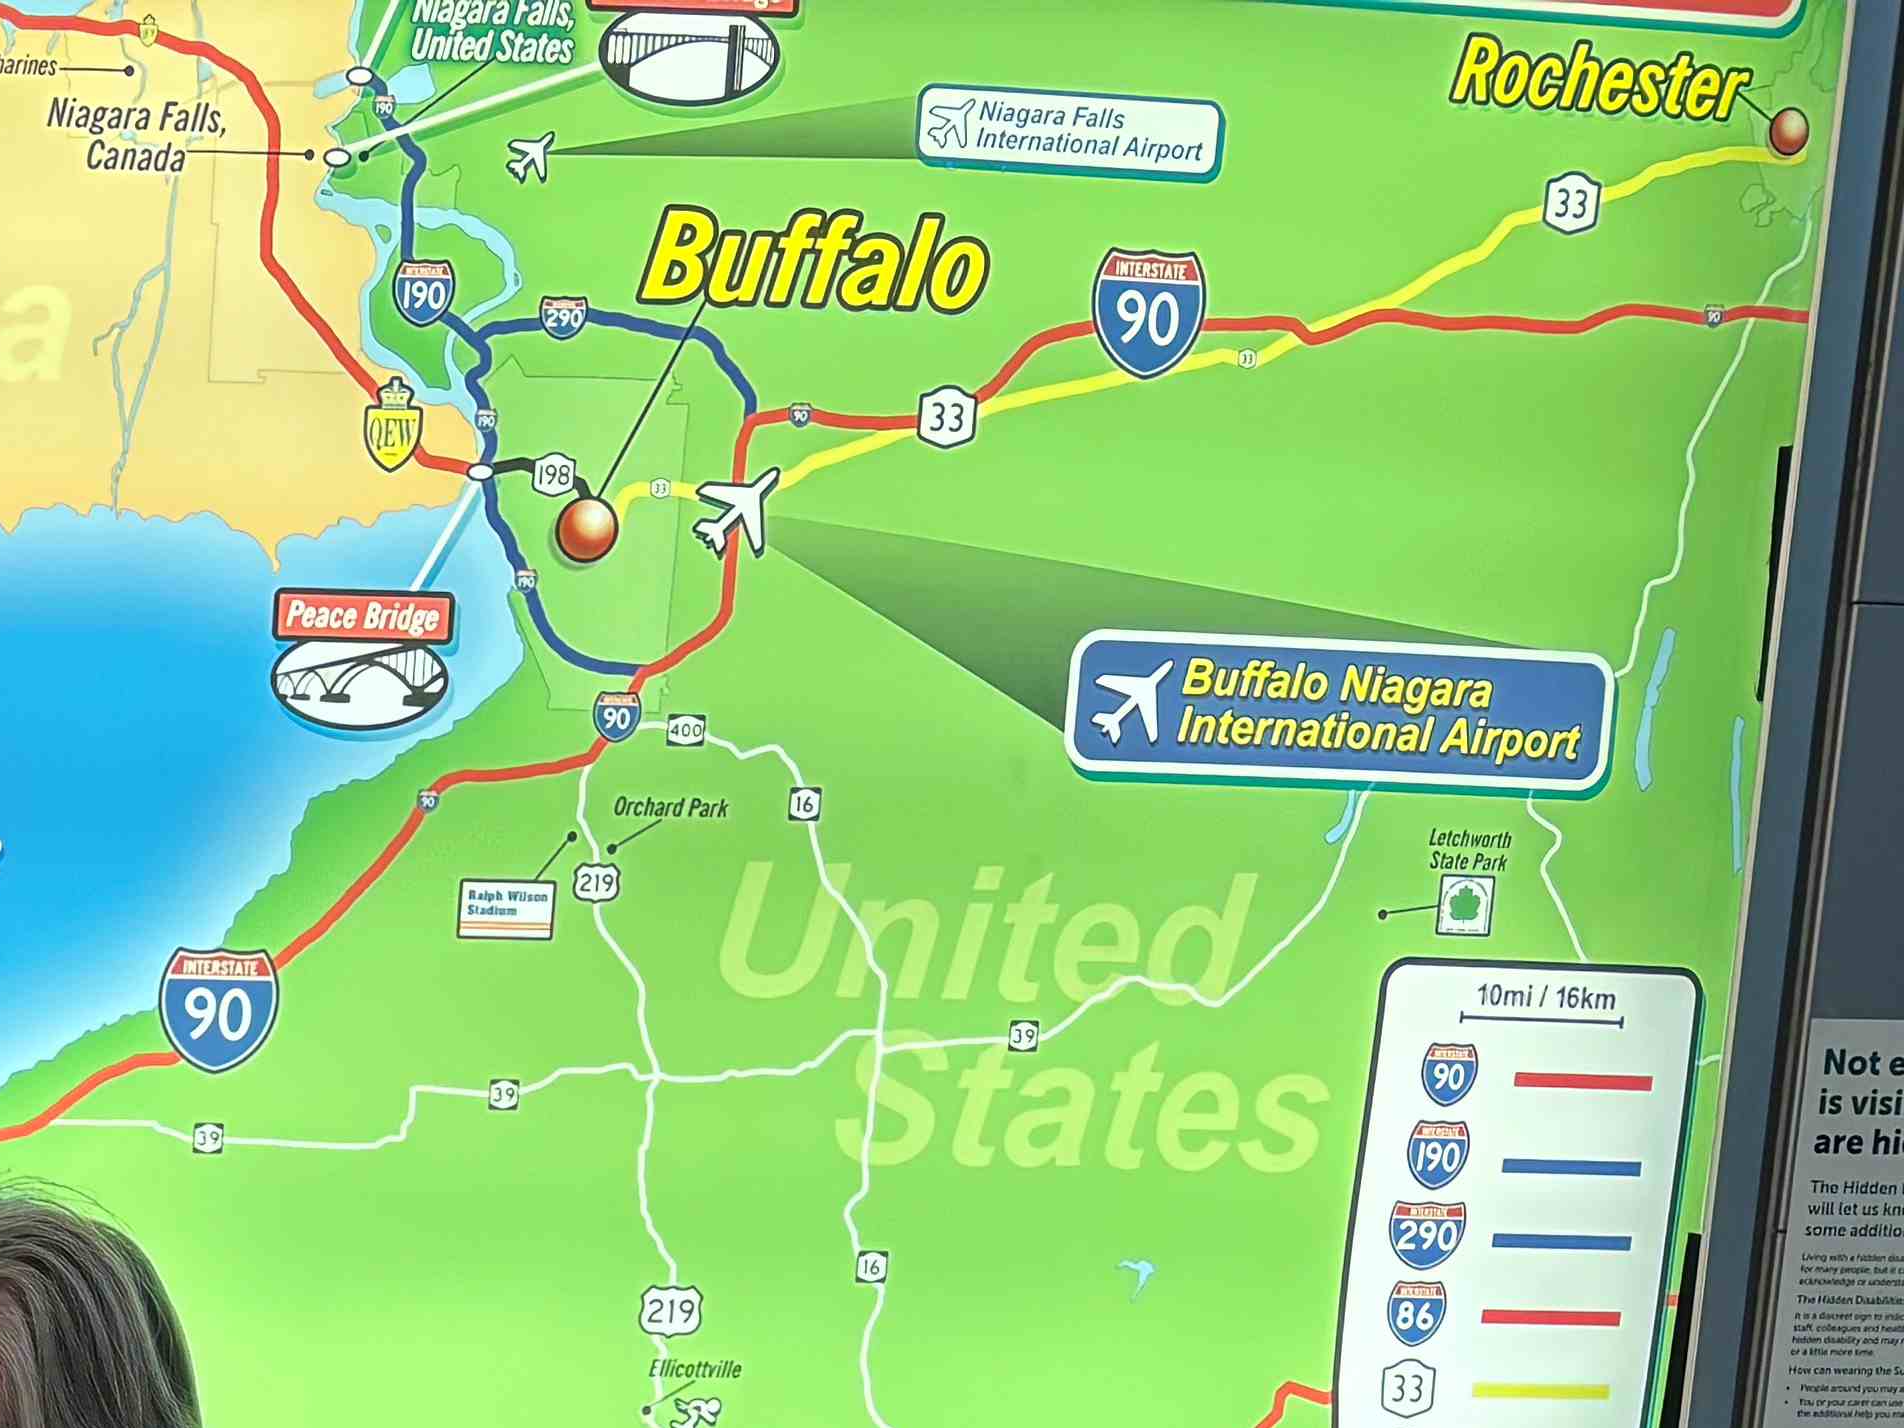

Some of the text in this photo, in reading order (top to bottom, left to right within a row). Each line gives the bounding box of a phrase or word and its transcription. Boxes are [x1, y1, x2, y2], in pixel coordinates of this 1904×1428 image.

[412, 0, 575, 32] Niagara Falls,
[411, 32, 575, 64] United States
[1450, 33, 1752, 121] Rochester
[47, 97, 227, 138] Niagara Falls,
[978, 101, 1125, 131] Niagara Falls
[86, 139, 187, 173] Canada
[975, 128, 1205, 165] International Airport
[639, 204, 990, 314] Buffalo
[1114, 259, 1189, 281] INTERSTATE
[402, 280, 446, 310] 190
[545, 308, 583, 328] 290
[1115, 289, 1180, 347] 90
[370, 416, 416, 448] QEW
[928, 403, 964, 432] 33
[536, 464, 571, 487] 198
[286, 599, 440, 635] Peace Bridge
[1180, 657, 1494, 710] Buffalo Niagara
[669, 721, 702, 740] 400
[1177, 706, 1582, 763] International Airport
[613, 795, 729, 820] Orchard Park
[1429, 827, 1512, 850] Letchworth
[1430, 852, 1508, 873] State Park
[467, 904, 518, 917] Stadium
[468, 889, 548, 904] Ralph Wilson
[718, 861, 1258, 1008] United
[183, 957, 258, 978] INTERSTATE
[1477, 983, 1616, 1012] 10mi 16km
[183, 986, 252, 1043] 90
[1823, 1048, 1880, 1076] Not
[834, 1030, 1330, 1174] States
[1813, 1134, 1863, 1154] are
[647, 1297, 694, 1326] 219
[649, 1358, 742, 1381] Ellicottville
